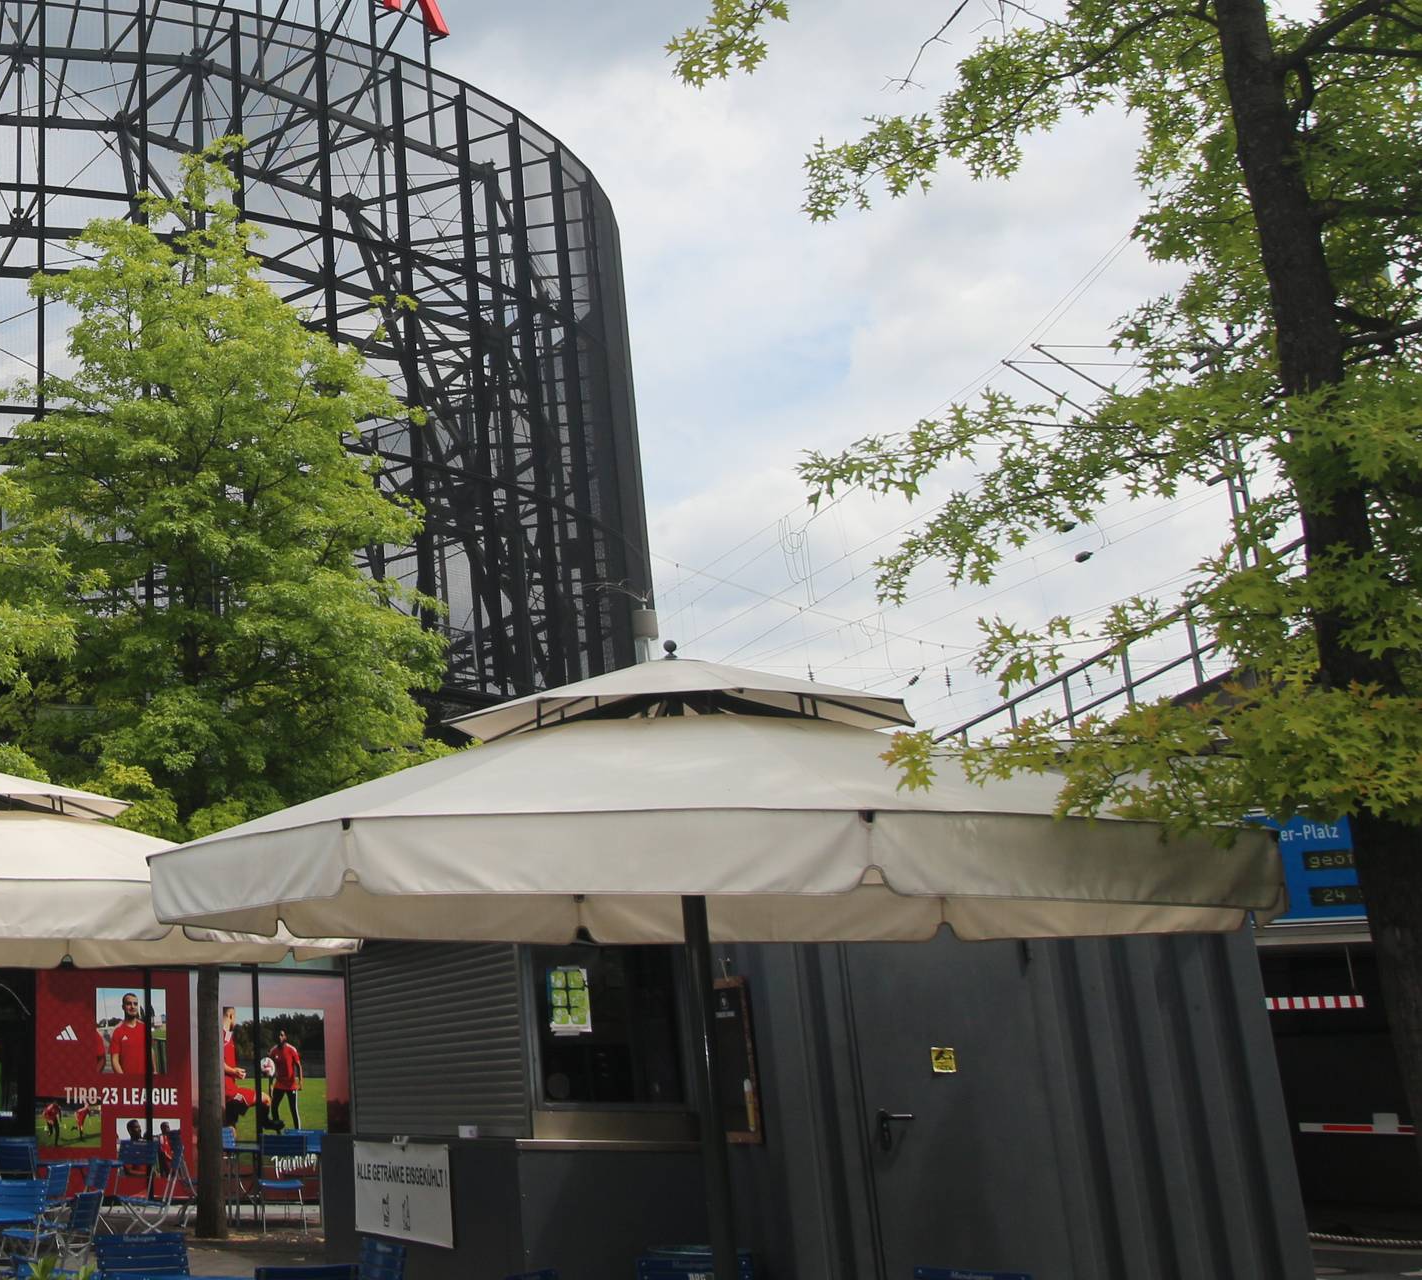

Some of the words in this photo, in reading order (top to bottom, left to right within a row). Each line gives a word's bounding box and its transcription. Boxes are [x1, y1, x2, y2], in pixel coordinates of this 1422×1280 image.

[102, 1087, 119, 1105] 23
[123, 1087, 178, 1106] LEAGUE
[270, 1153, 318, 1179] Training
[358, 1163, 371, 1180] ALLE
[373, 1161, 405, 1184] GETRÄNKE
[406, 1164, 444, 1188] EISGEKÜHLT
